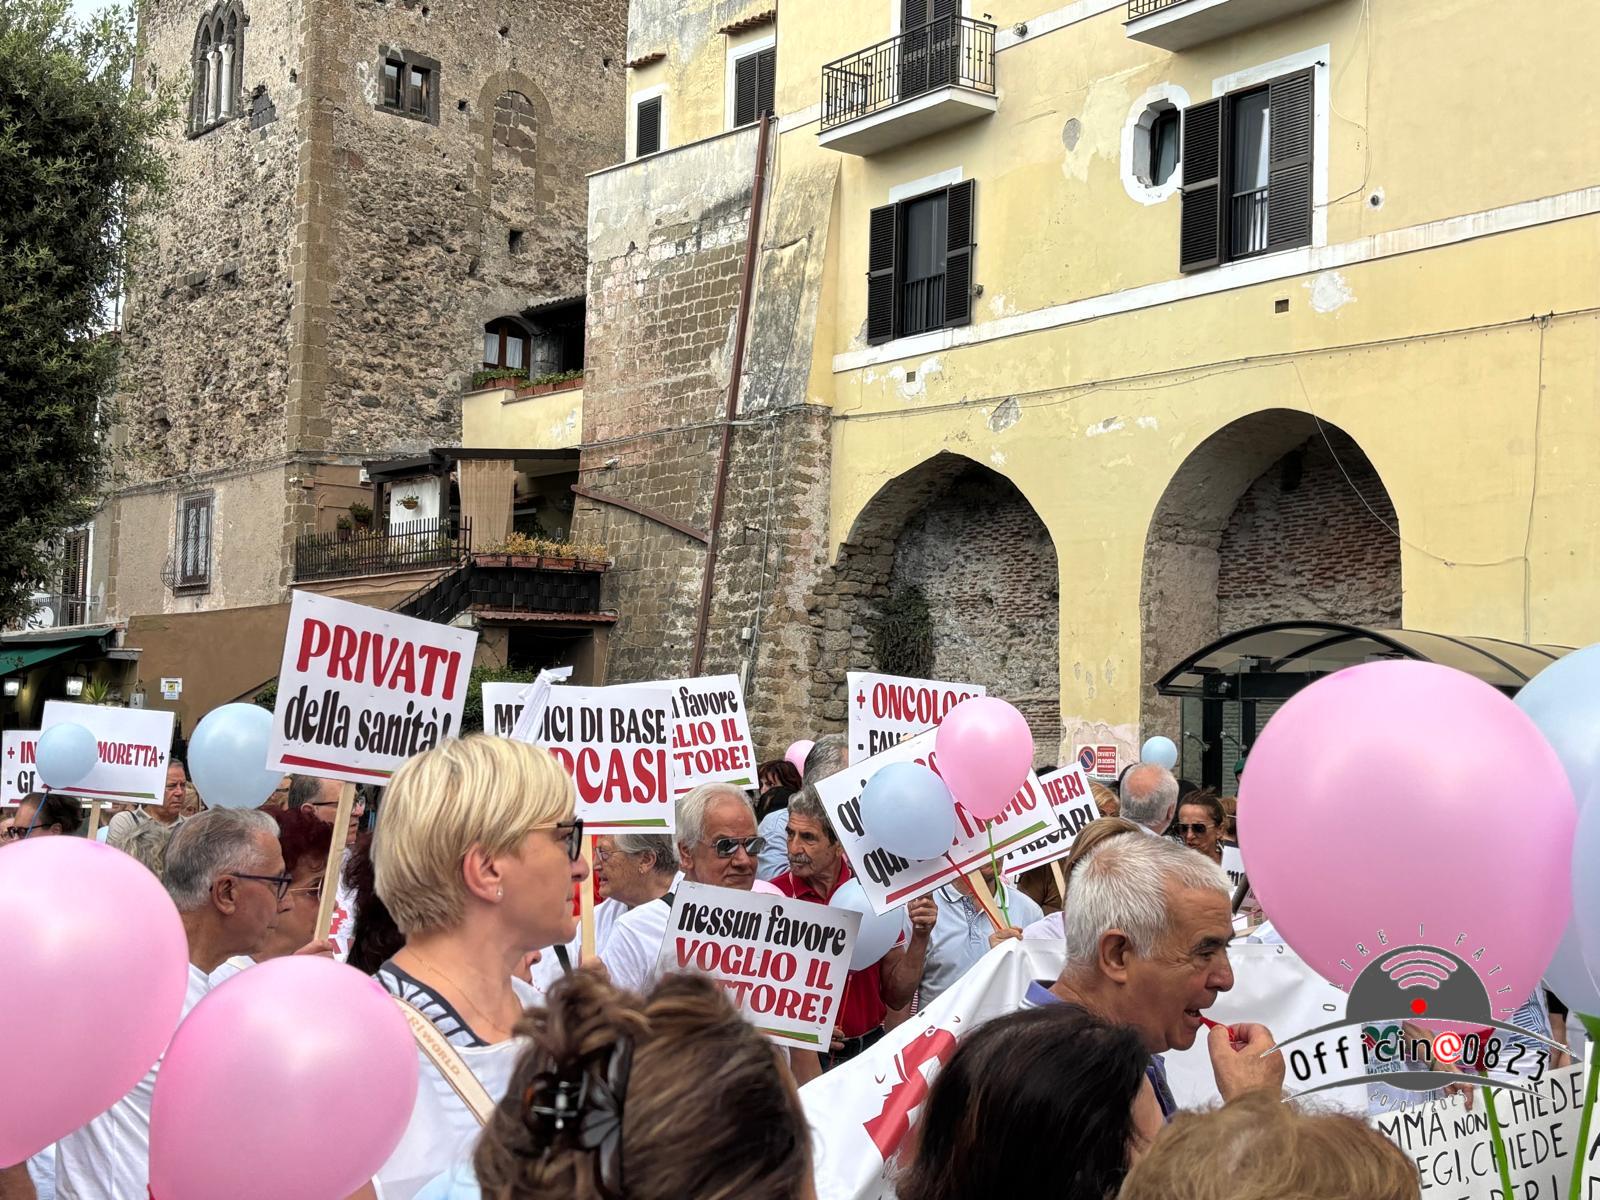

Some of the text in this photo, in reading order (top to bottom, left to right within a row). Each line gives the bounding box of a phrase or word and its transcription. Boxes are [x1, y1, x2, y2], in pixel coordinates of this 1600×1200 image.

[296, 618, 461, 700] PRIVATI
[284, 685, 351, 748] della
[494, 704, 667, 744] MICI DI BASE
[679, 686, 738, 718] favore
[873, 683, 979, 725] ONCOLO
[673, 718, 744, 748] LIO IL
[673, 745, 751, 776] TORE!
[678, 902, 846, 956] nessun favore
[675, 937, 833, 991] VOGLIO IL
[714, 978, 833, 1025] TORE!
[1378, 1071, 1584, 1150] MMA NON CHIEDE
[1416, 1149, 1470, 1189] EGI,
